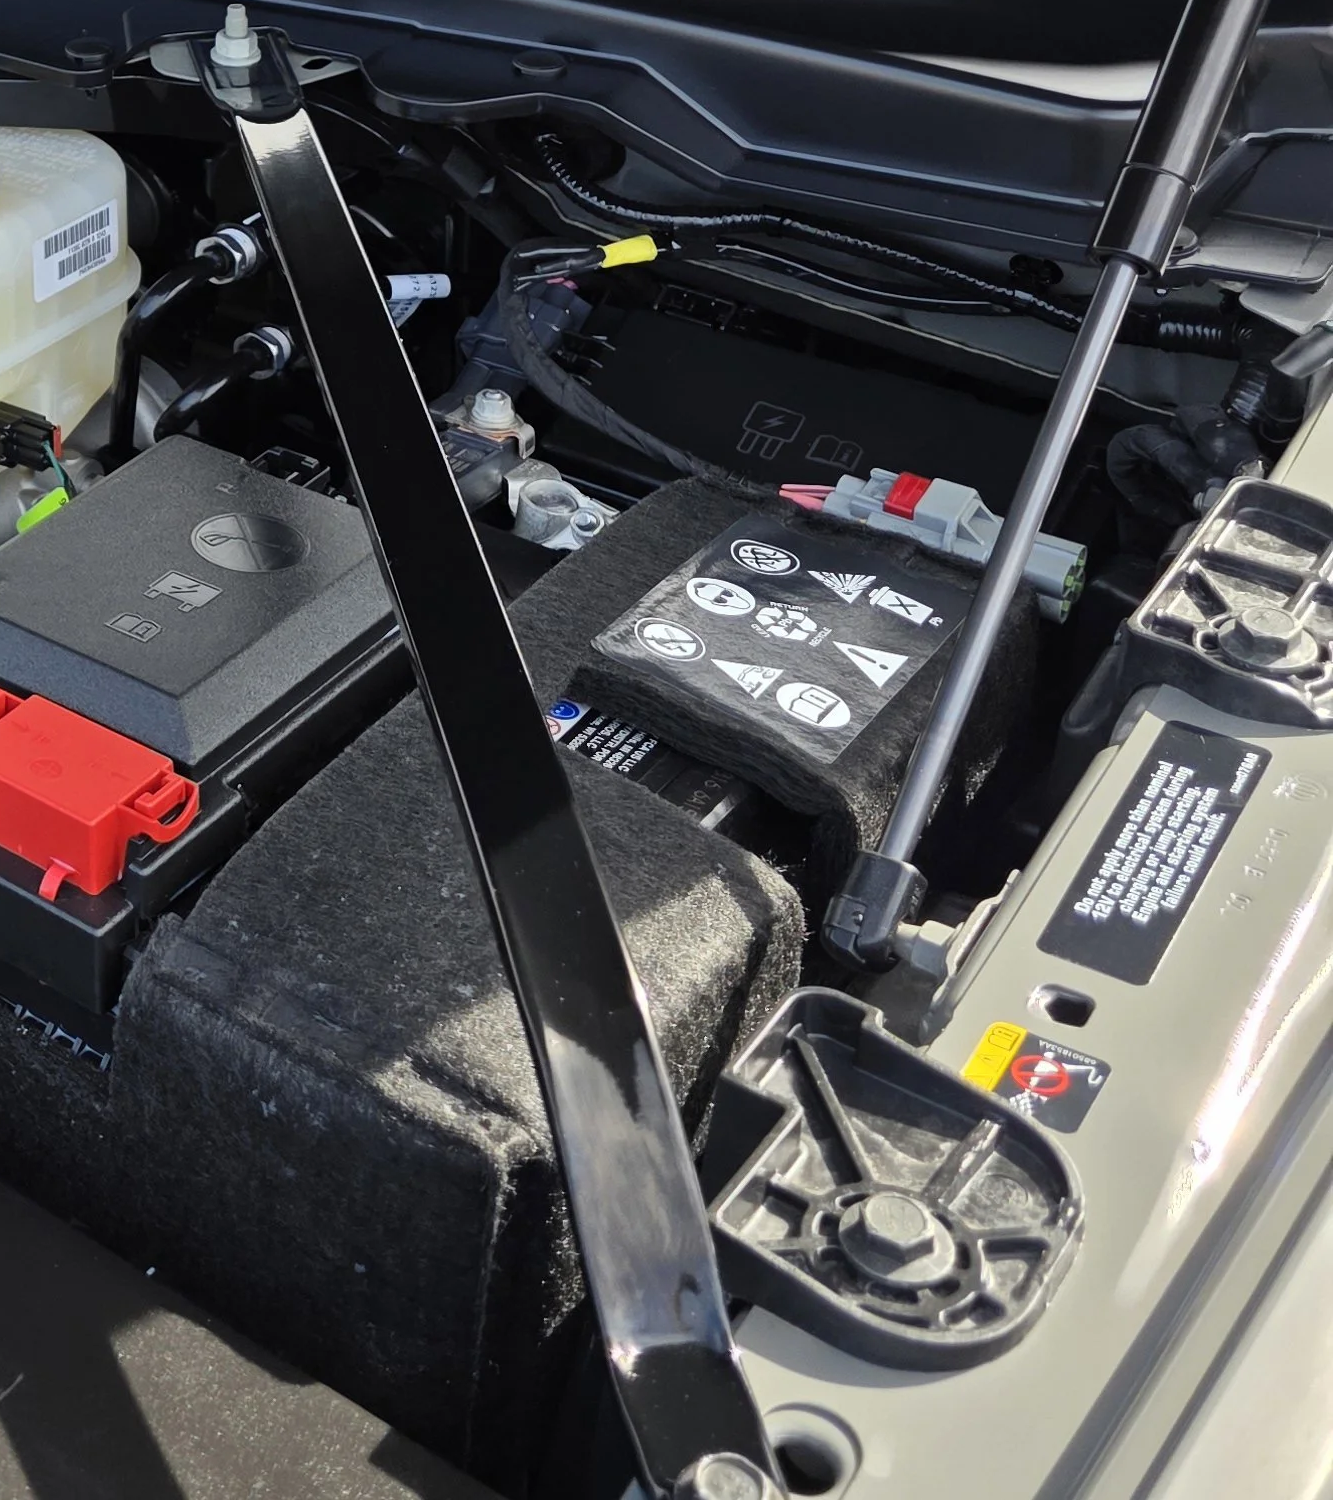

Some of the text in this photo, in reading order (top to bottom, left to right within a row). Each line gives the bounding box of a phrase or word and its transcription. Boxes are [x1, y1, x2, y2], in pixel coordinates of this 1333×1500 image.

[770, 601, 809, 612] RETURN
[808, 626, 833, 647] RECYCLE
[587, 734, 603, 749] LLC
[618, 757, 637, 772] LLC
[632, 748, 646, 761] US
[1074, 760, 1174, 916] Do not apply more than nominal
[1092, 765, 1194, 920] 12V to electrical system during
[1119, 786, 1201, 914] charging or jump starting.
[1131, 787, 1220, 923] Engine and starting system
[1160, 813, 1227, 910] failure could result.
